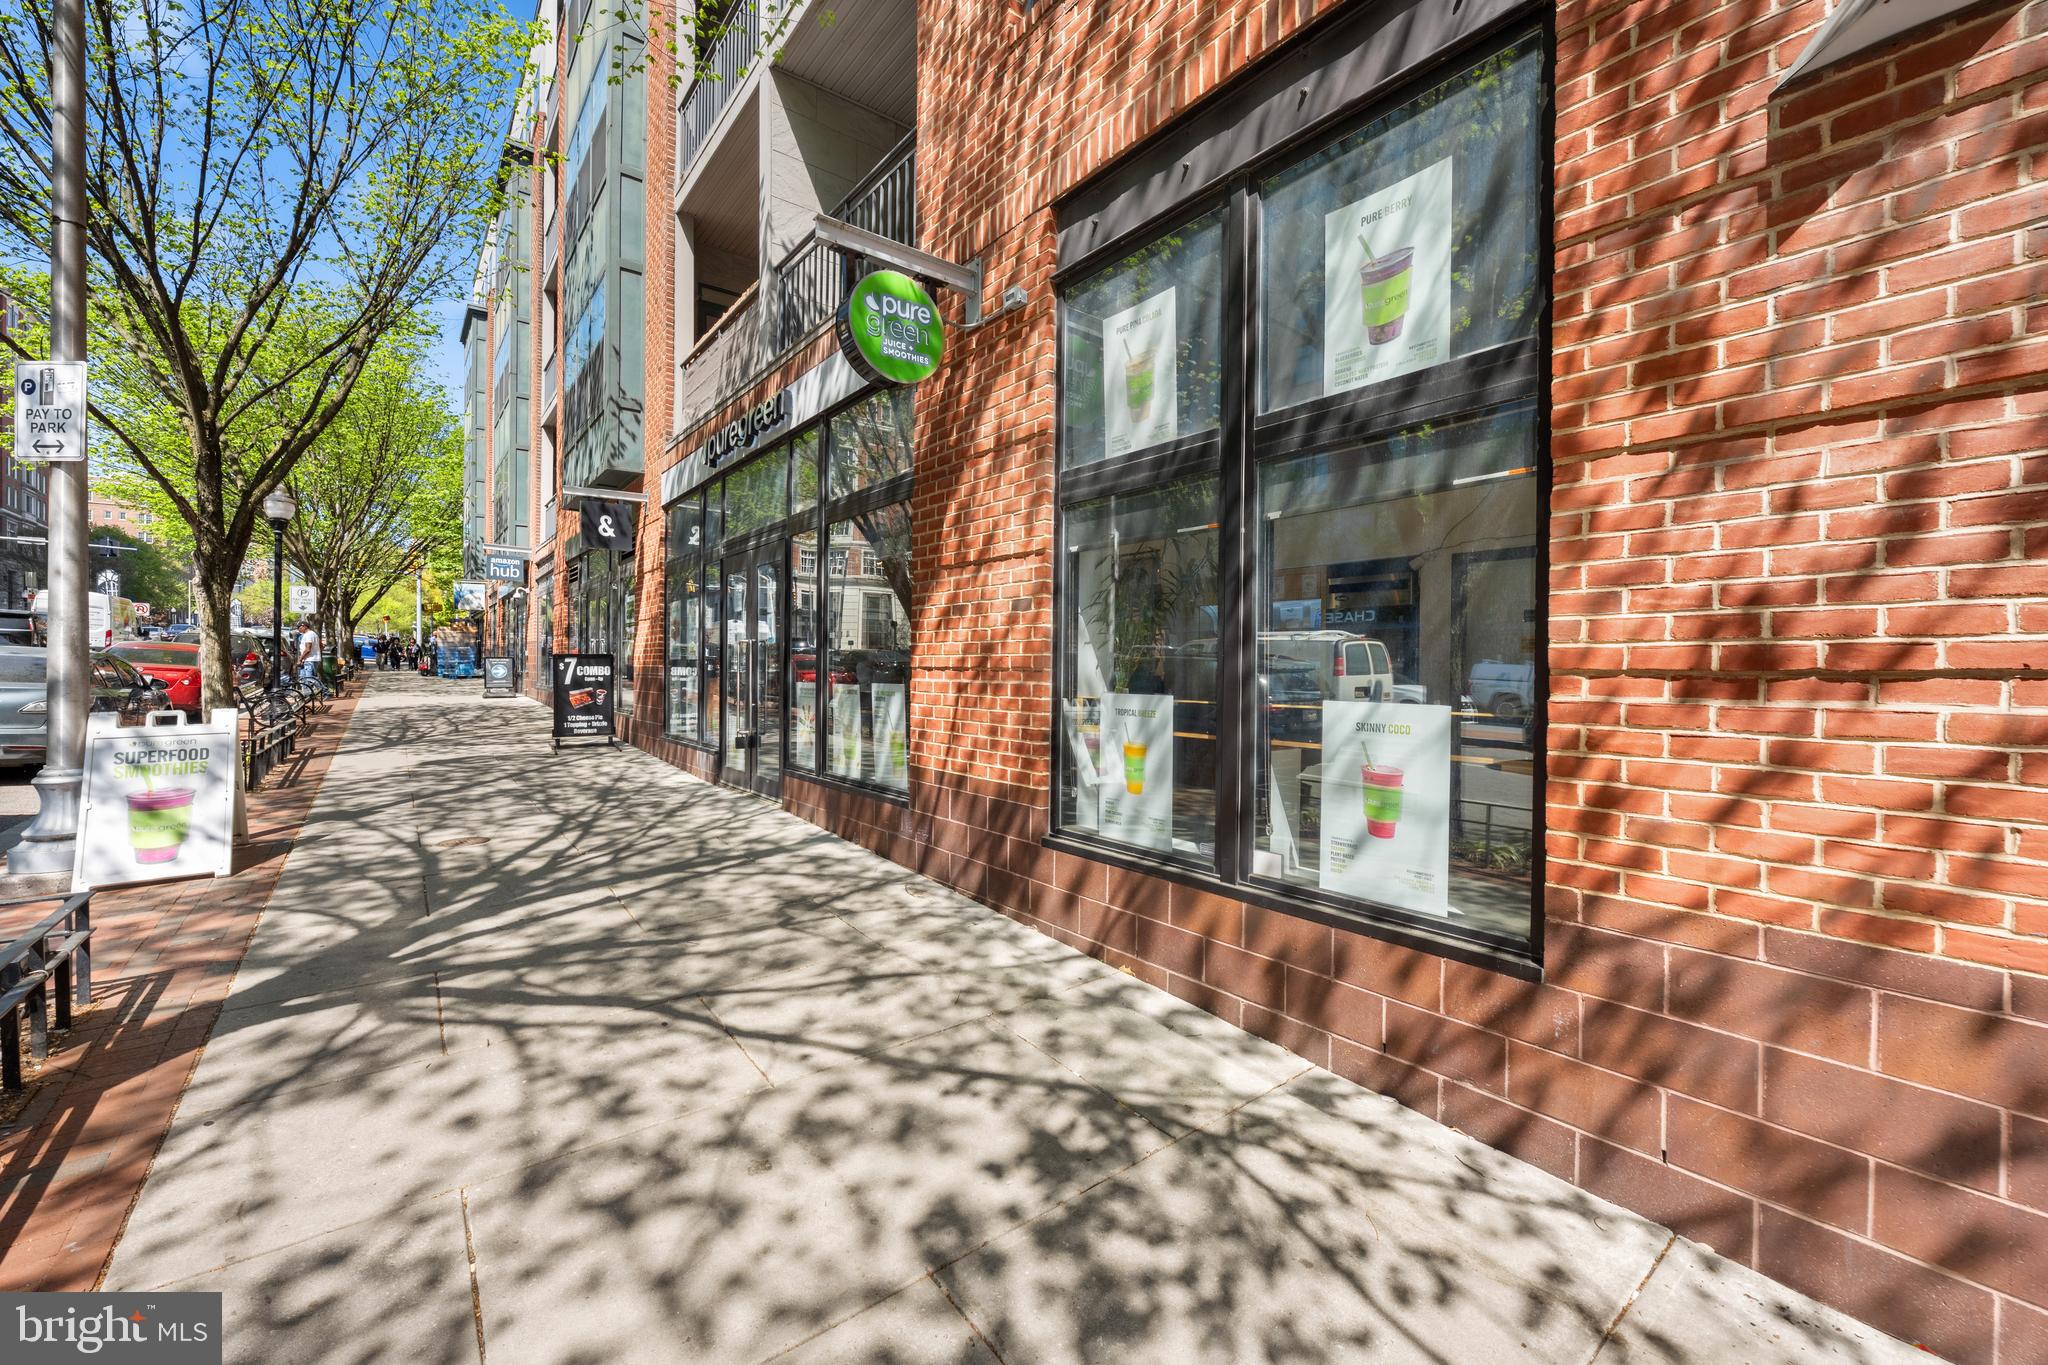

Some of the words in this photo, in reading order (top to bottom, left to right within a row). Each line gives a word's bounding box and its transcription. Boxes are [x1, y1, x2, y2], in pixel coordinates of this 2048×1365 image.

[1360, 209, 1383, 227] PURE
[1384, 194, 1414, 217] BERRY
[882, 295, 931, 324] pure
[866, 314, 929, 346] green
[883, 338, 907, 350] JUICE
[883, 347, 929, 365] SMOOTHIES
[26, 408, 50, 420] PAY
[54, 408, 72, 420] TO
[30, 422, 66, 433] PARK
[490, 556, 521, 566] amazon
[490, 563, 520, 578] hub
[576, 665, 611, 676] COMBO
[1115, 707, 1137, 717] TROPICAL
[1355, 721, 1387, 734] SKINNY
[1388, 724, 1411, 735] COCO
[113, 747, 210, 765] SUPERFOOD
